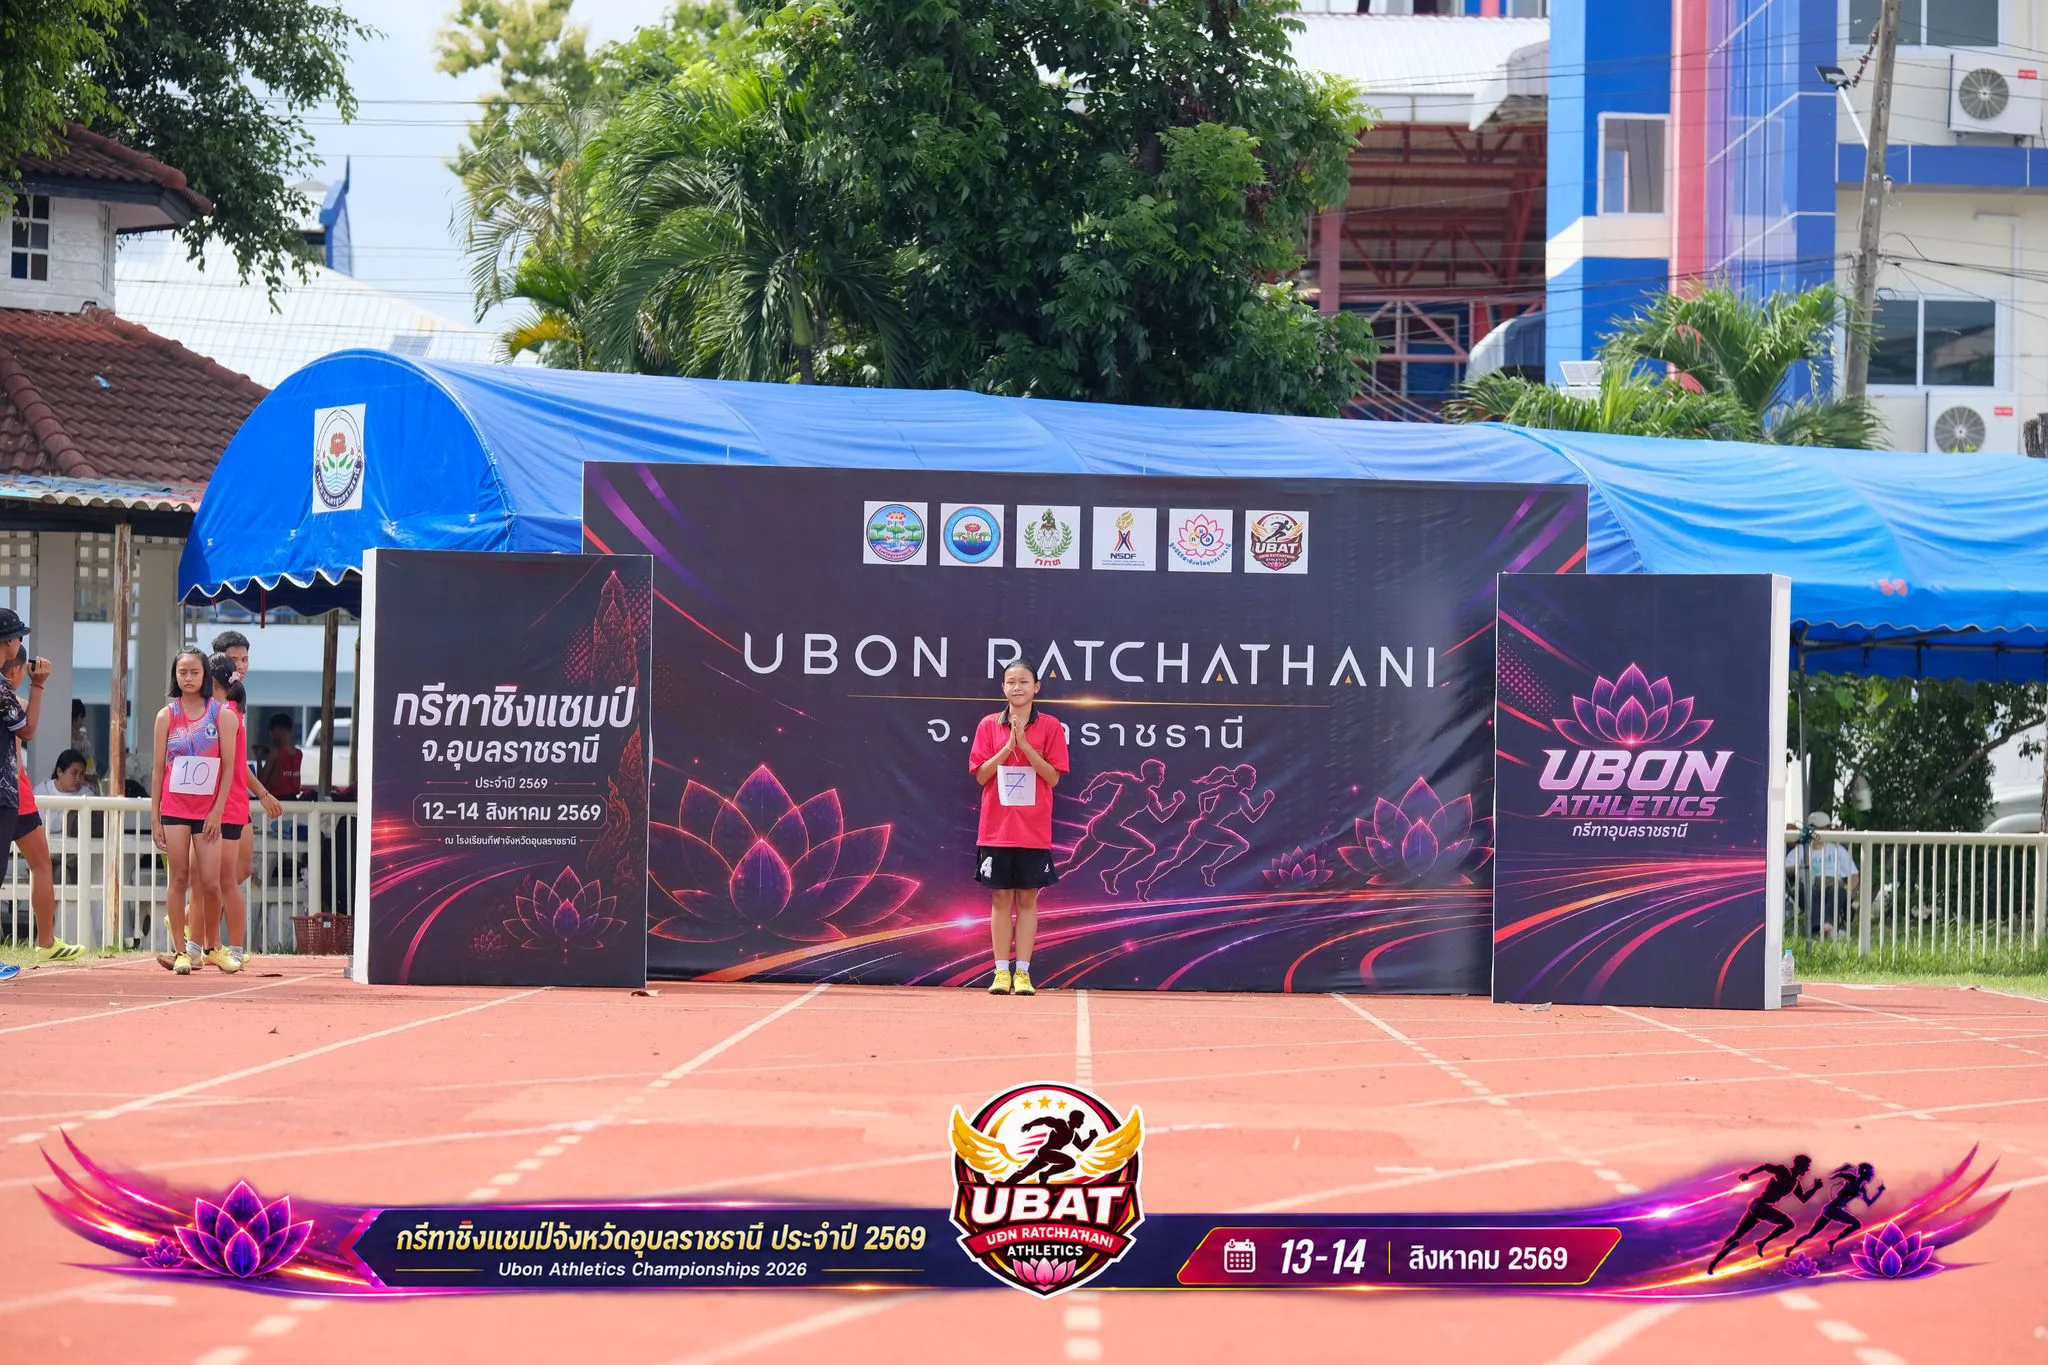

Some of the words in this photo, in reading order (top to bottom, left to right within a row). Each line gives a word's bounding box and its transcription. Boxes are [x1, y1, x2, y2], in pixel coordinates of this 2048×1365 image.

[1110, 552, 1137, 560] NSDF
[1255, 543, 1298, 554] UBAT
[744, 632, 948, 678] UBON
[988, 637, 1436, 689] RATCHATHANI
[394, 683, 636, 729] กรีฑาชิงแชมป์
[179, 760, 210, 786] 10
[1539, 749, 1735, 792] UBON
[475, 776, 515, 789] ประจำปี
[519, 778, 548, 789] 2569
[1005, 772, 1026, 797] 7
[485, 802, 551, 821] สิงหาคม
[557, 804, 601, 821] 2569
[1540, 795, 1727, 818] ATHLETICS
[456, 834, 577, 848] โรงเรียนกีฬาจังหวัดอุบลราชธานี
[1572, 821, 1689, 842] กรีฑาอุบลราชธานี
